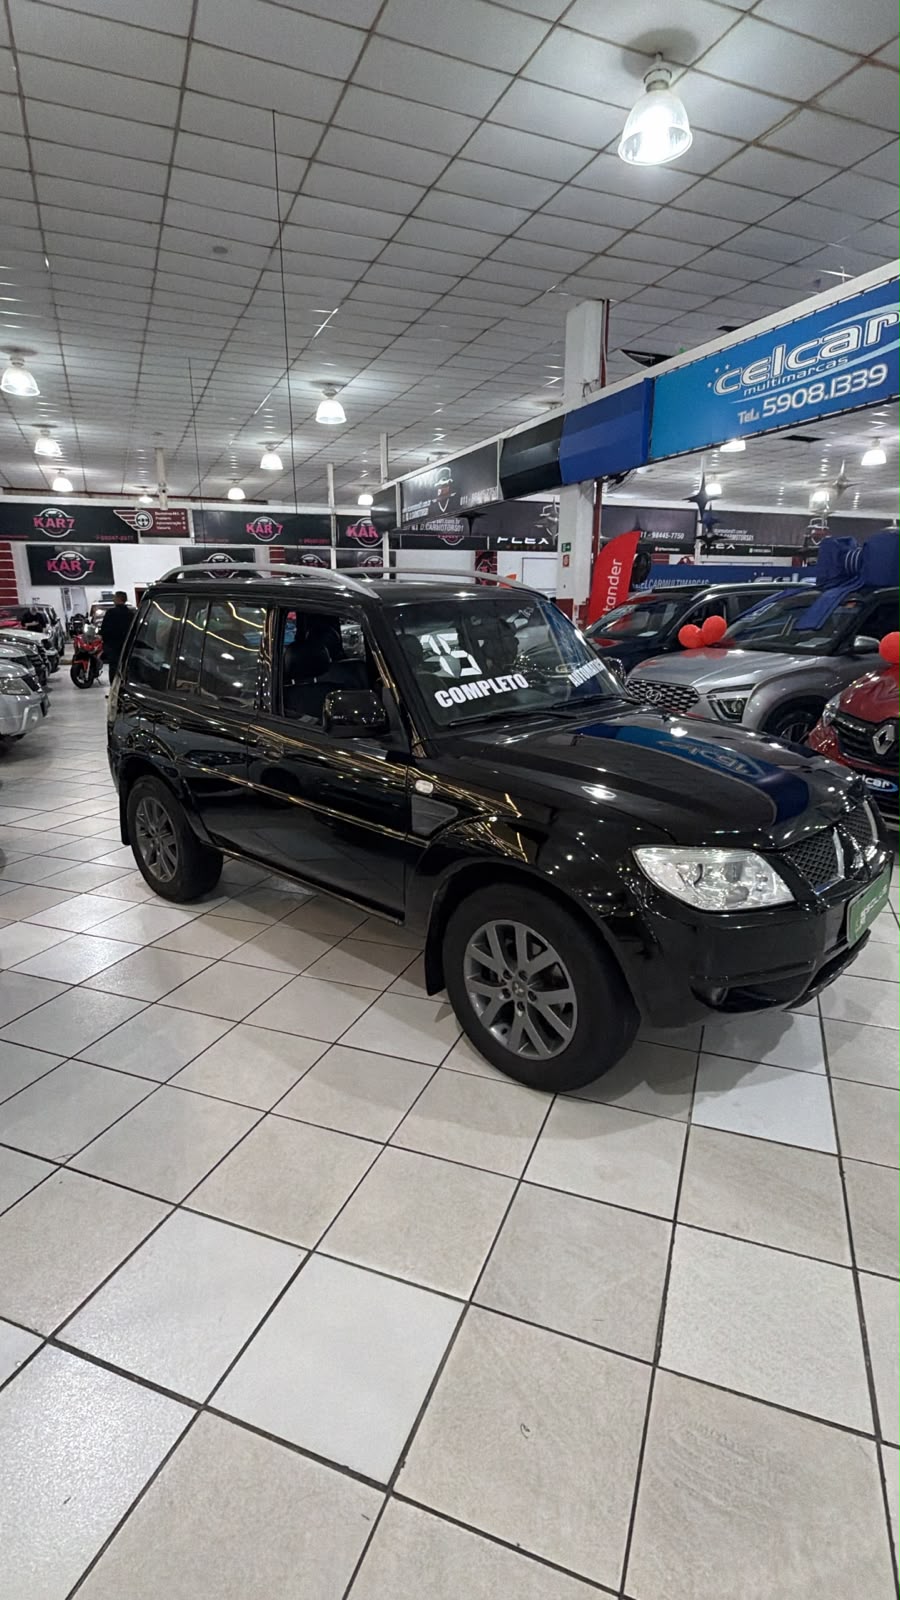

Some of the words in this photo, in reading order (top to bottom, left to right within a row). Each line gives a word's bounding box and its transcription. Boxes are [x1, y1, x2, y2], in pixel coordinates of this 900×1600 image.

[714, 311, 899, 395] celcar
[743, 356, 849, 396] multimarcas
[762, 363, 888, 418] 5908.1339
[46, 560, 81, 571] KAR
[434, 674, 529, 708] COMPLETO
